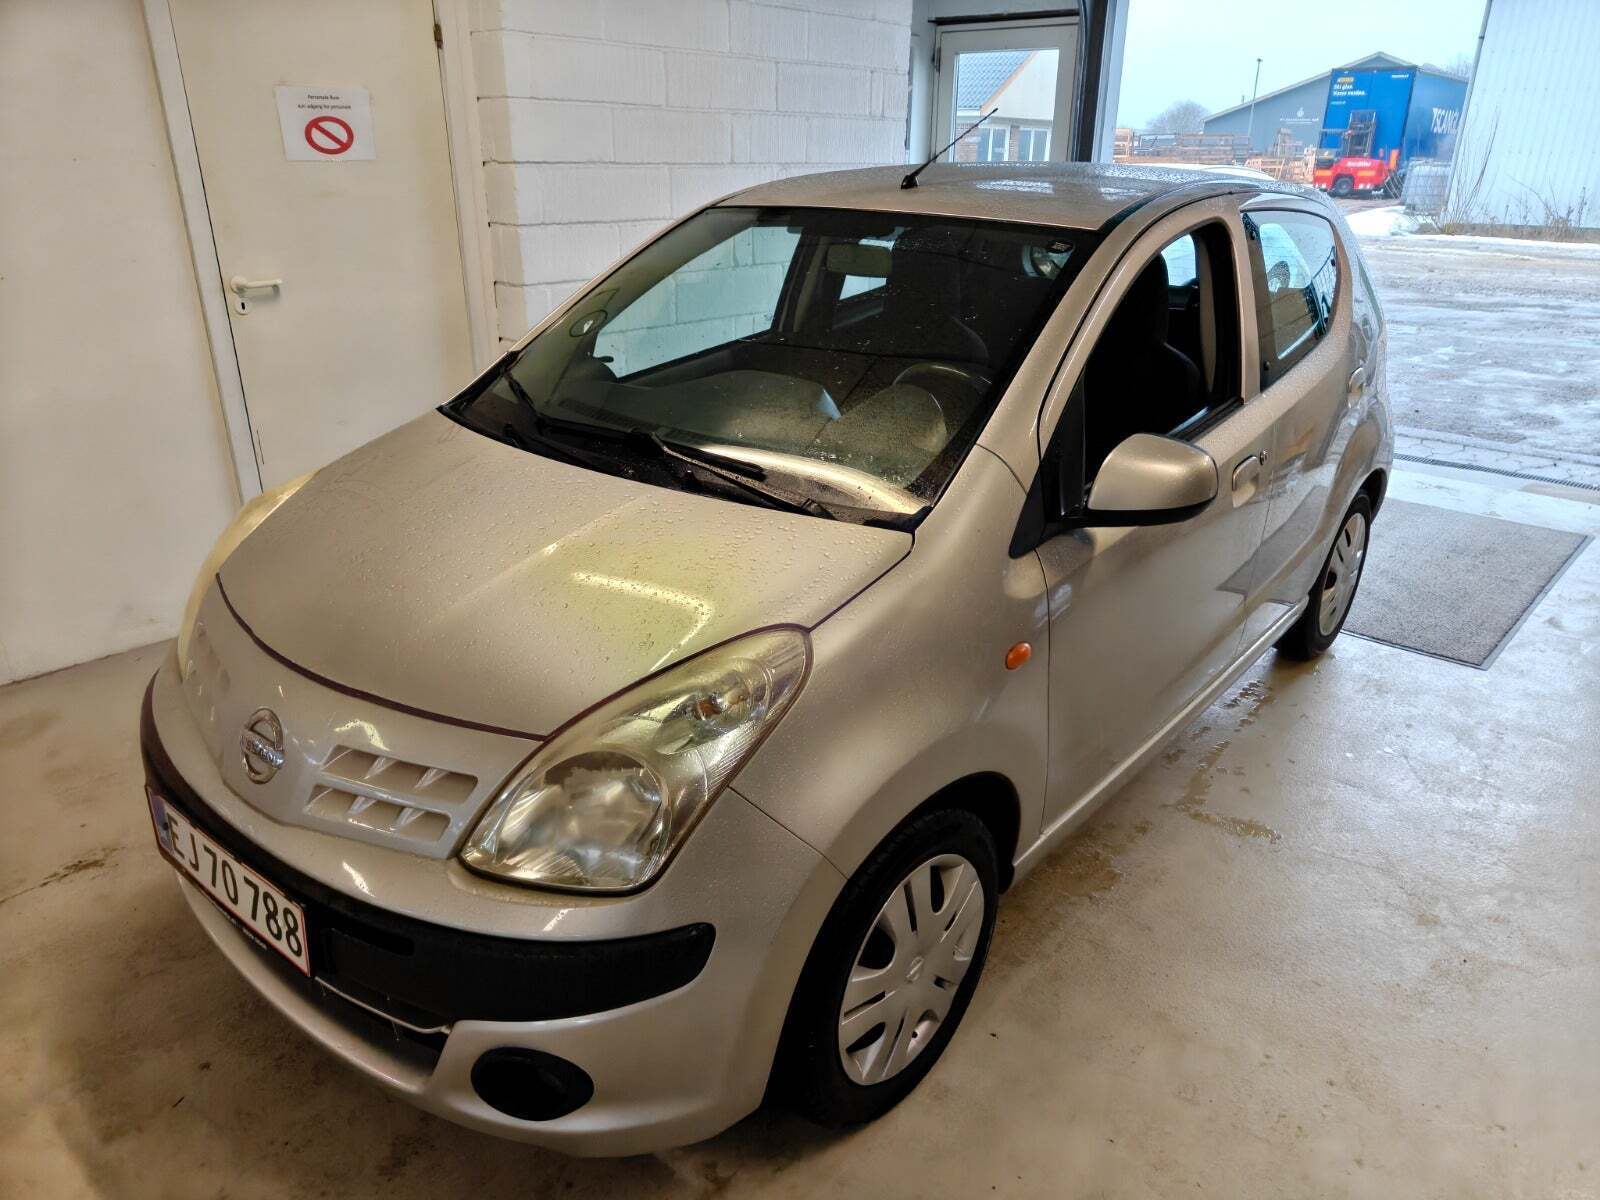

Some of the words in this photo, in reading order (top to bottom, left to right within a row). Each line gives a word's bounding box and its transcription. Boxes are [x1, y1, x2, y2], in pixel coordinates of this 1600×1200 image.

[166, 812, 200, 872] EJ
[203, 844, 239, 906] 70
[243, 875, 303, 958] 788
